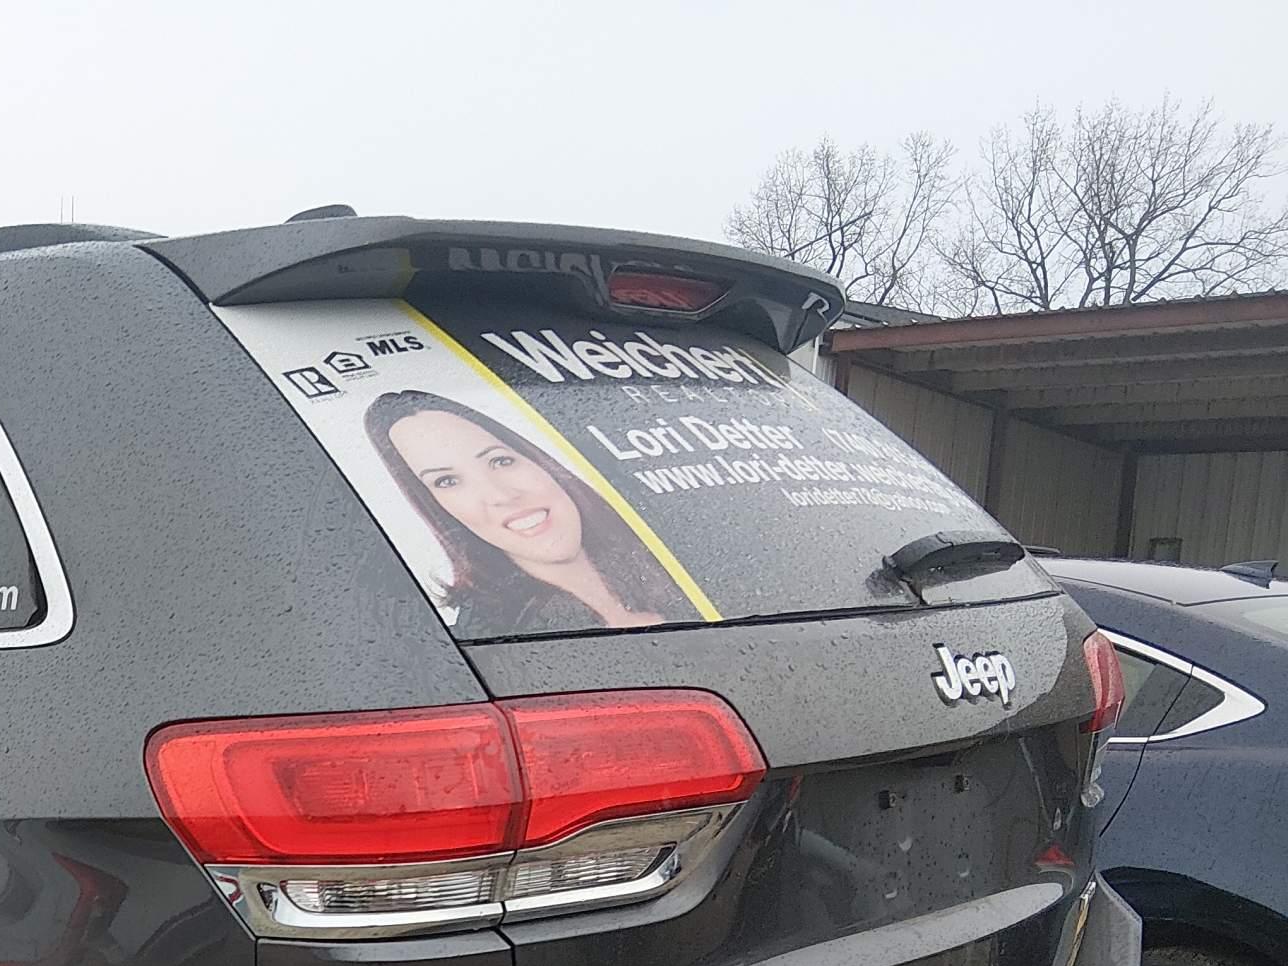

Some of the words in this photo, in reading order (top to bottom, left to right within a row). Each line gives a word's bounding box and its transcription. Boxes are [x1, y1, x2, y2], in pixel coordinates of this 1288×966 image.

[366, 336, 424, 356] MLS
[481, 330, 785, 388] Weichert
[587, 418, 694, 460] Lori
[679, 416, 804, 450] Detter
[934, 645, 1016, 704] Jeep
